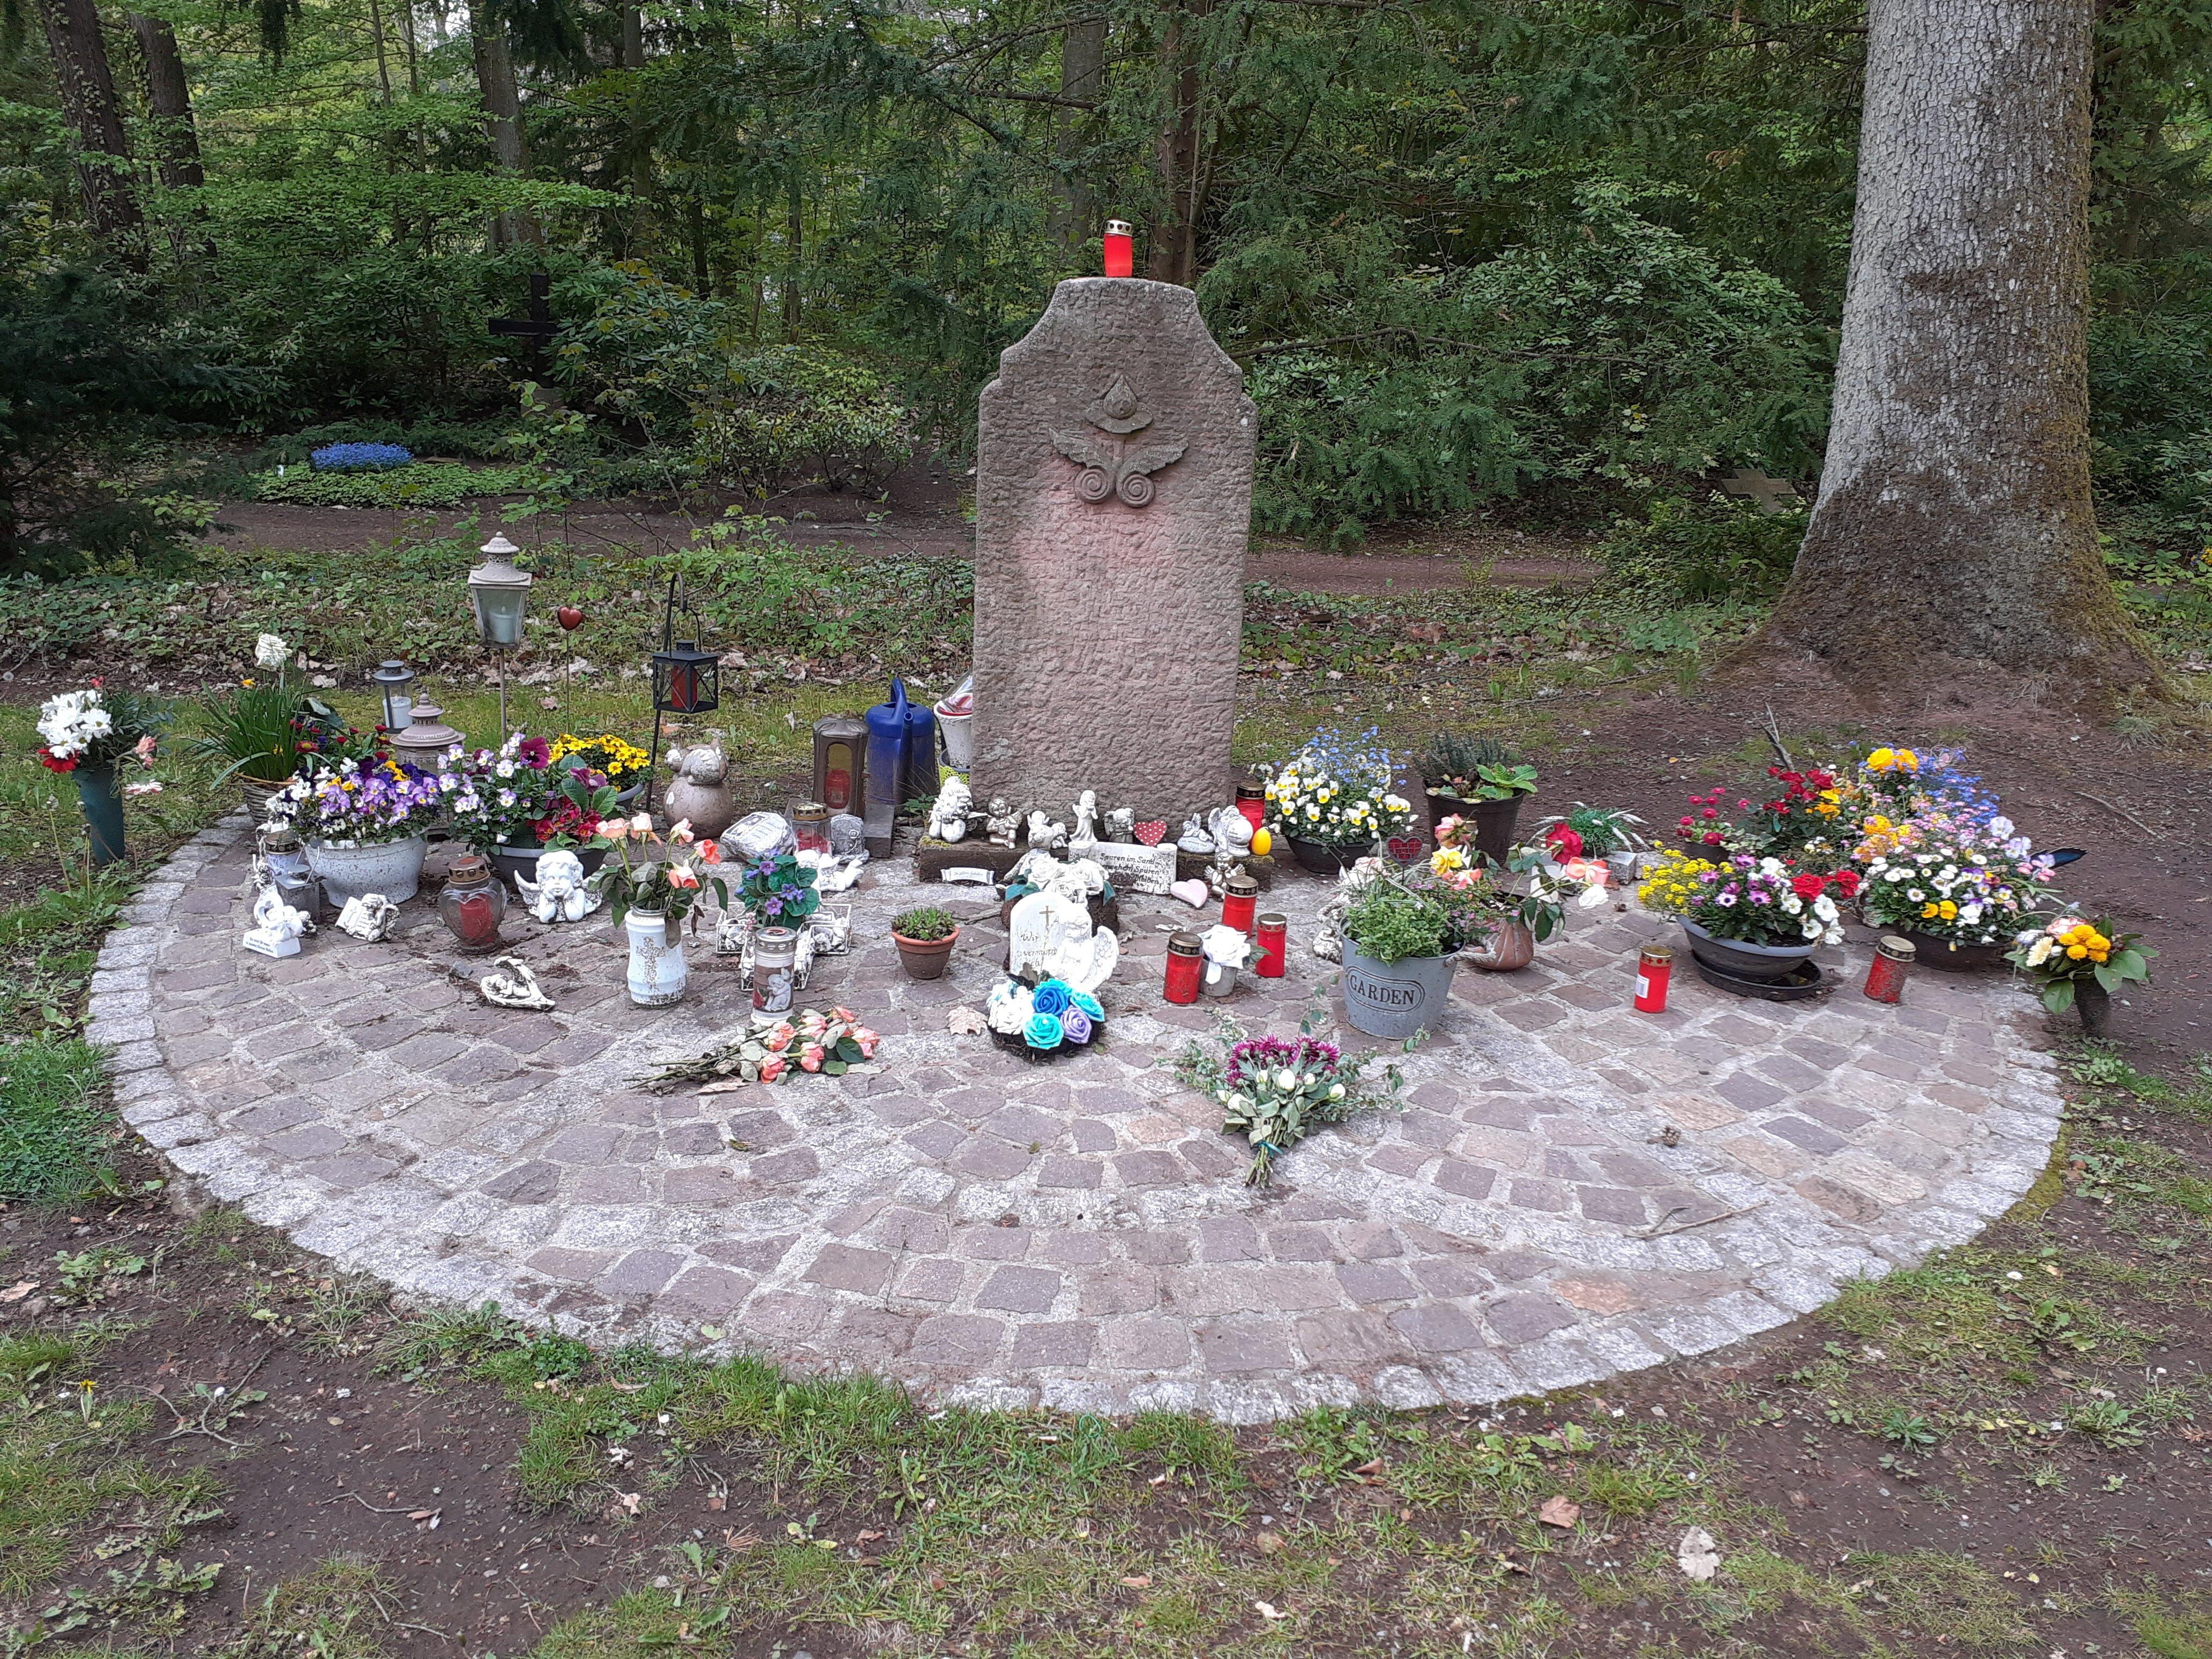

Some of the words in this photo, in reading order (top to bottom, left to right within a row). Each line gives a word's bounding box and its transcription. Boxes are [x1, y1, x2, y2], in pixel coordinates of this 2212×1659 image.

[1100, 853, 1125, 861] Spuren
[1021, 931, 1039, 941] Wir
[1350, 974, 1415, 1005] GARDEN
